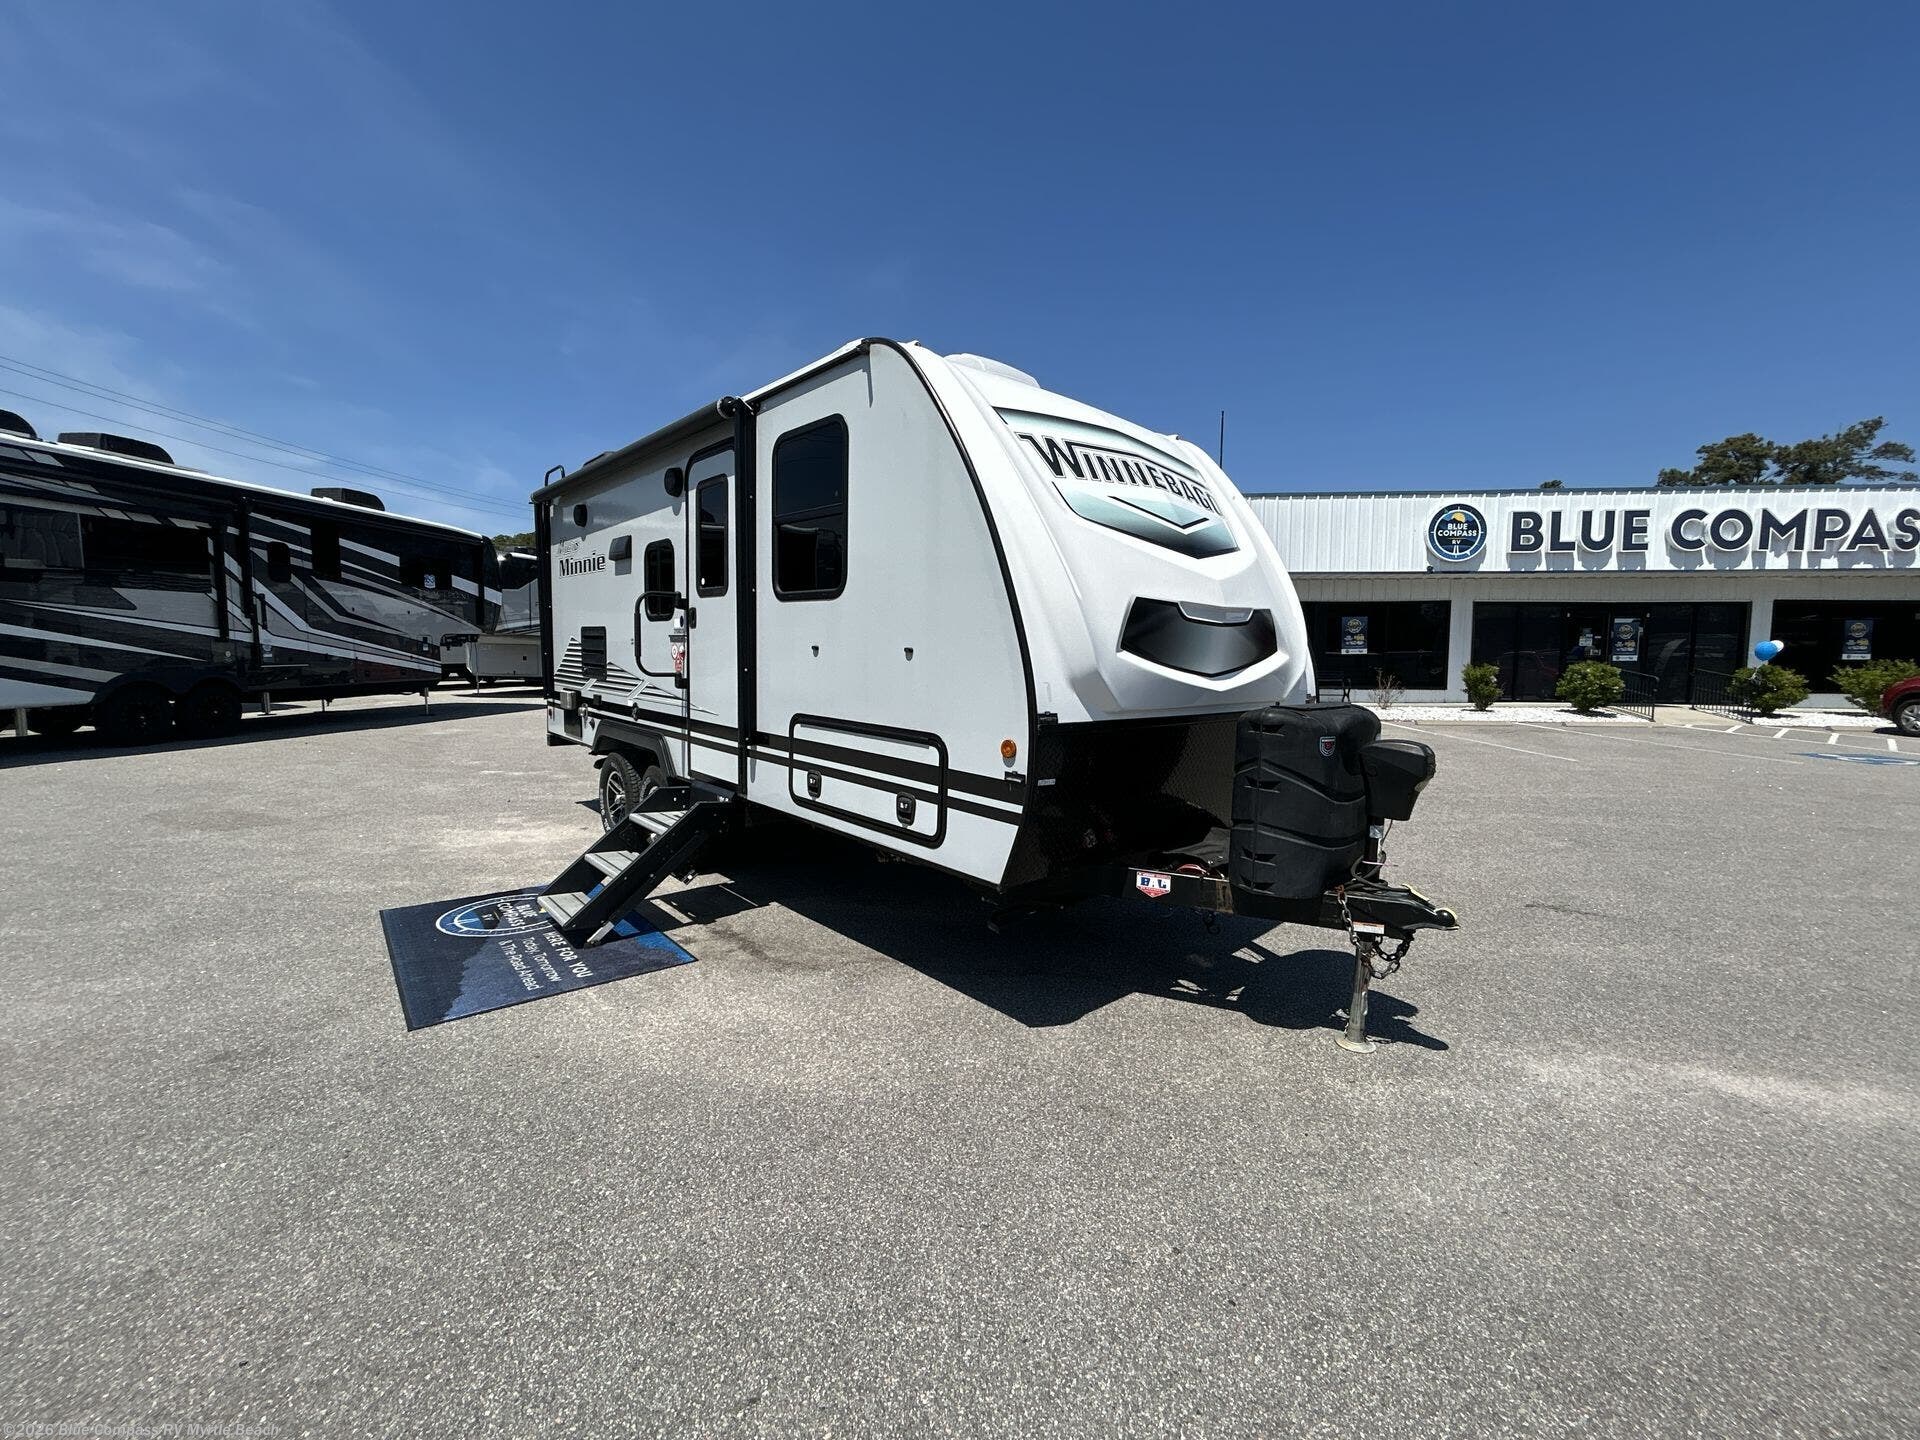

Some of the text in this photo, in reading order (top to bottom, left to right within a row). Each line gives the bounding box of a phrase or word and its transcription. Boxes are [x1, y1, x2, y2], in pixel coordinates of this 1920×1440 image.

[1437, 529, 1478, 537] COMPASS
[1510, 507, 1920, 552] BLUE COMPAS
[559, 552, 605, 577] Minnie
[497, 902, 526, 927] COMPASS
[516, 904, 538, 918] BLUE
[508, 954, 532, 971] Road
[542, 931, 594, 978] HERE FOR YOU
[518, 969, 544, 991] Ahead
